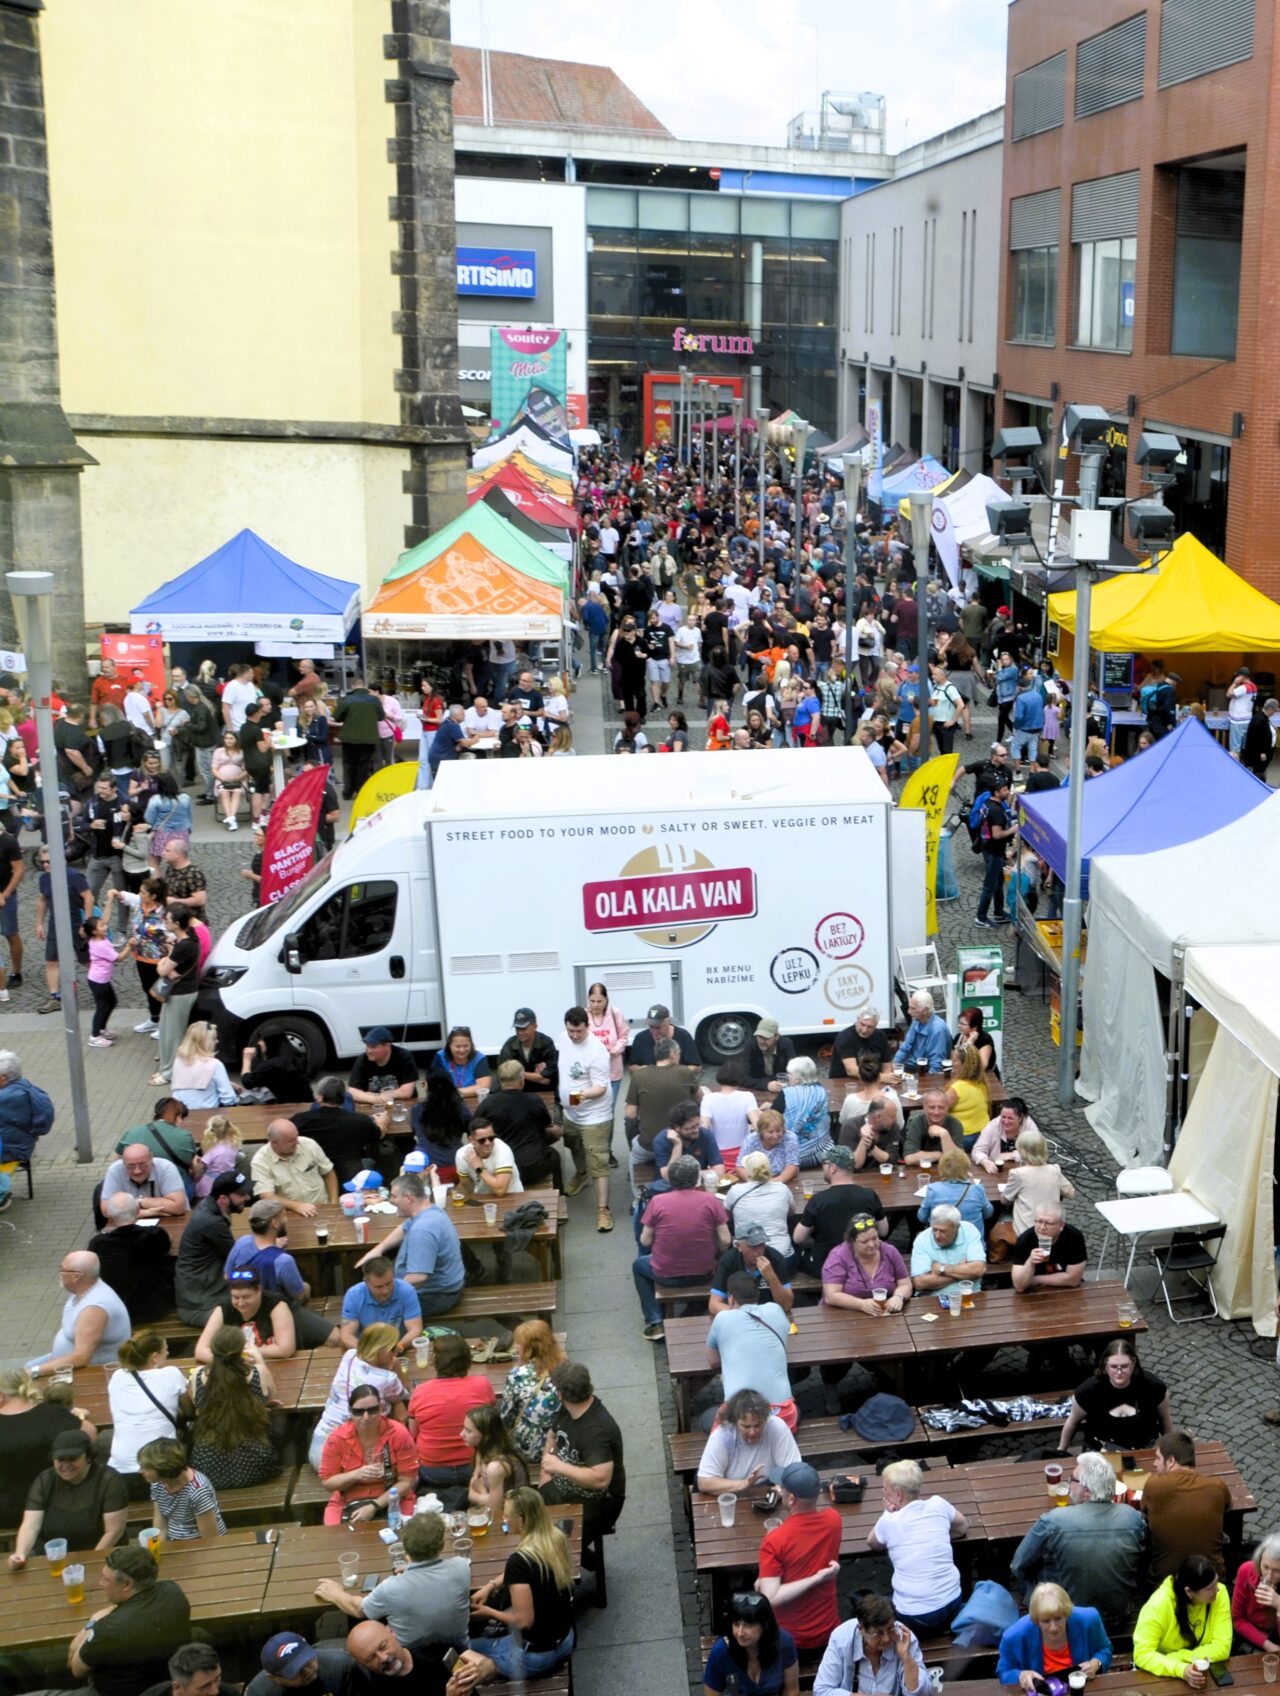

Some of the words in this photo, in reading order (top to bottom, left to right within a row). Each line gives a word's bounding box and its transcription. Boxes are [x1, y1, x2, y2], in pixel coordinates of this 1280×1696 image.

[673, 327, 754, 354] forum
[446, 830, 495, 841] STREET
[501, 829, 534, 839] FOOD
[540, 828, 555, 838] TO
[561, 827, 594, 837] YOUR
[600, 825, 636, 835] MOOD
[660, 822, 696, 833] SALTY
[701, 821, 718, 831] OR
[773, 817, 816, 828] VEGGIE
[821, 816, 838, 826] OR
[843, 814, 875, 825] MEAT
[274, 839, 307, 860] BLACK
[595, 890, 638, 918] OLA
[642, 884, 696, 914] KALA
[700, 879, 742, 908] VAN
[829, 922, 847, 935] BEZ
[706, 966, 719, 975] BX
[722, 965, 751, 973] MENU
[785, 957, 803, 971] BEZ
[782, 969, 811, 984] LEPKU
[837, 974, 859, 987] TAKY
[835, 986, 865, 1000] VEGAN
[982, 1018, 999, 1028] ED
